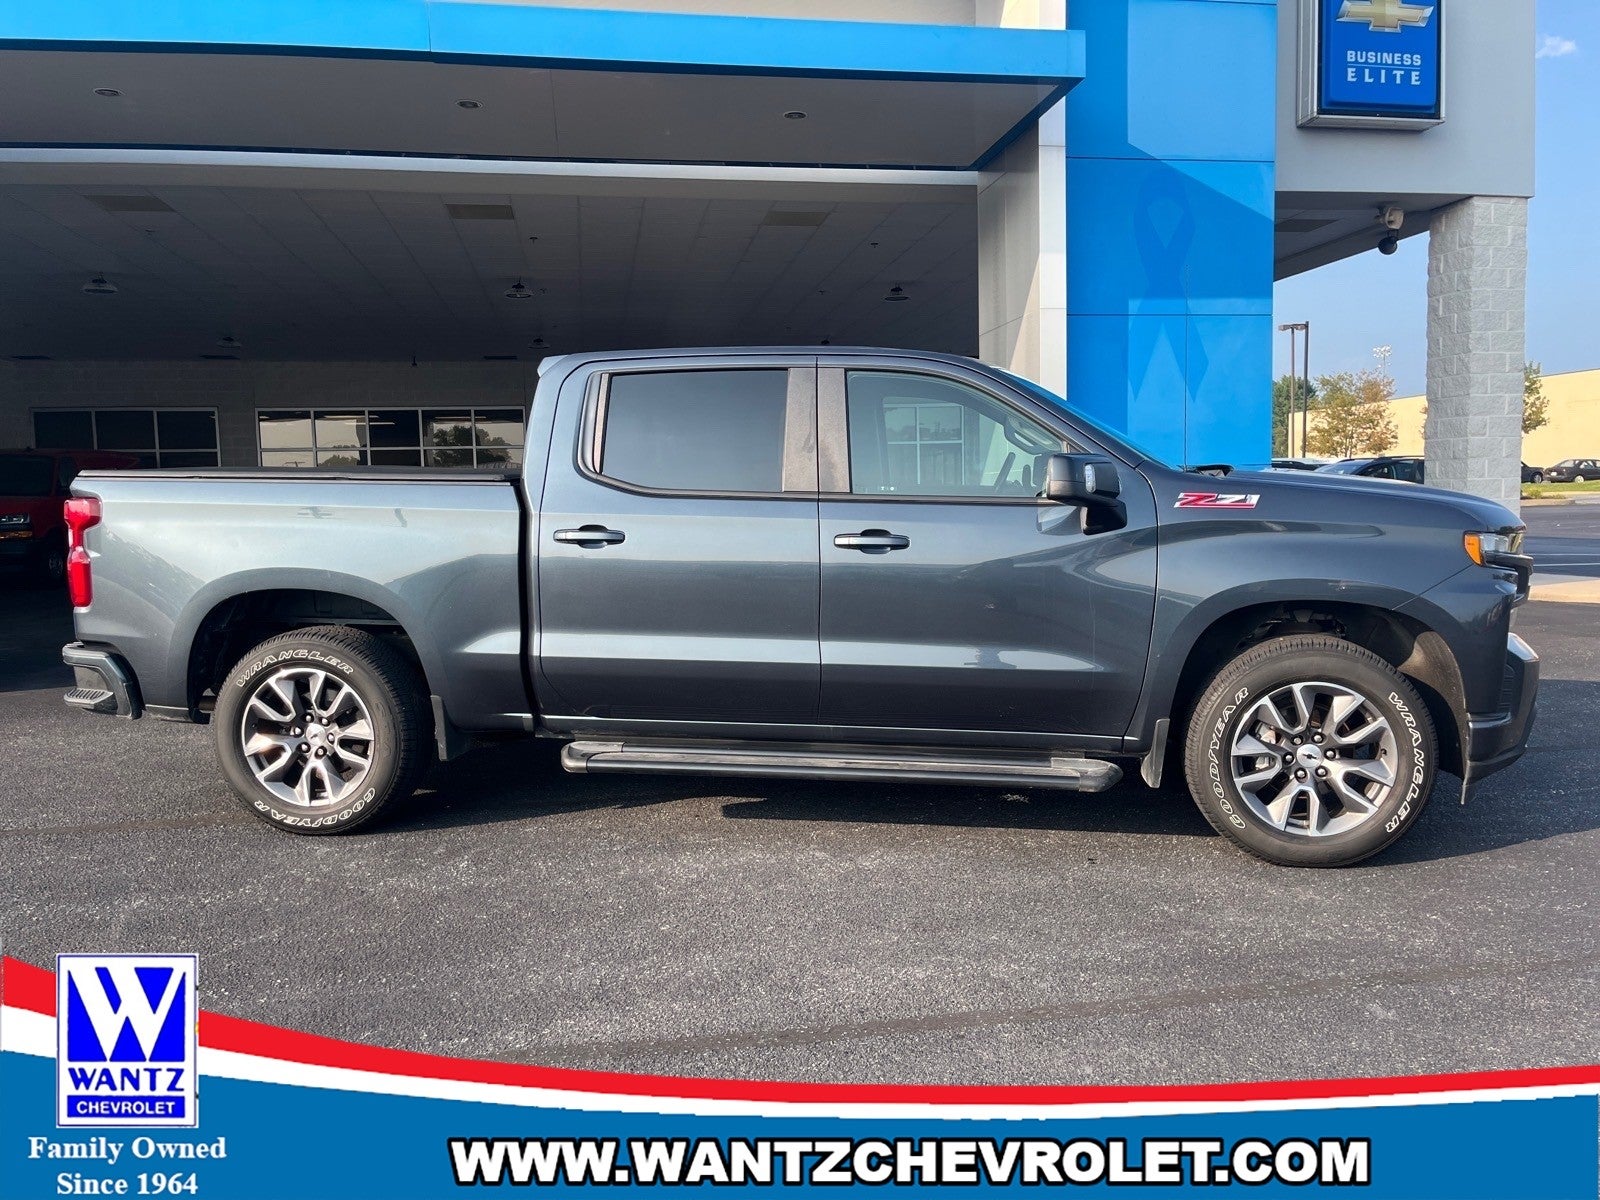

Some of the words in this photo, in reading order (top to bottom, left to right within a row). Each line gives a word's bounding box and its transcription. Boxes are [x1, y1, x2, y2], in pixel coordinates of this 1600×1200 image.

[1346, 50, 1422, 66] BUSINESS
[1346, 67, 1422, 86] ELITE
[1173, 492, 1261, 509] Z71
[236, 650, 354, 687] WRANGLER
[1208, 687, 1248, 830] GOODYEAR
[1385, 692, 1425, 833] WRANGLER
[254, 787, 376, 828] GOODYEAR
